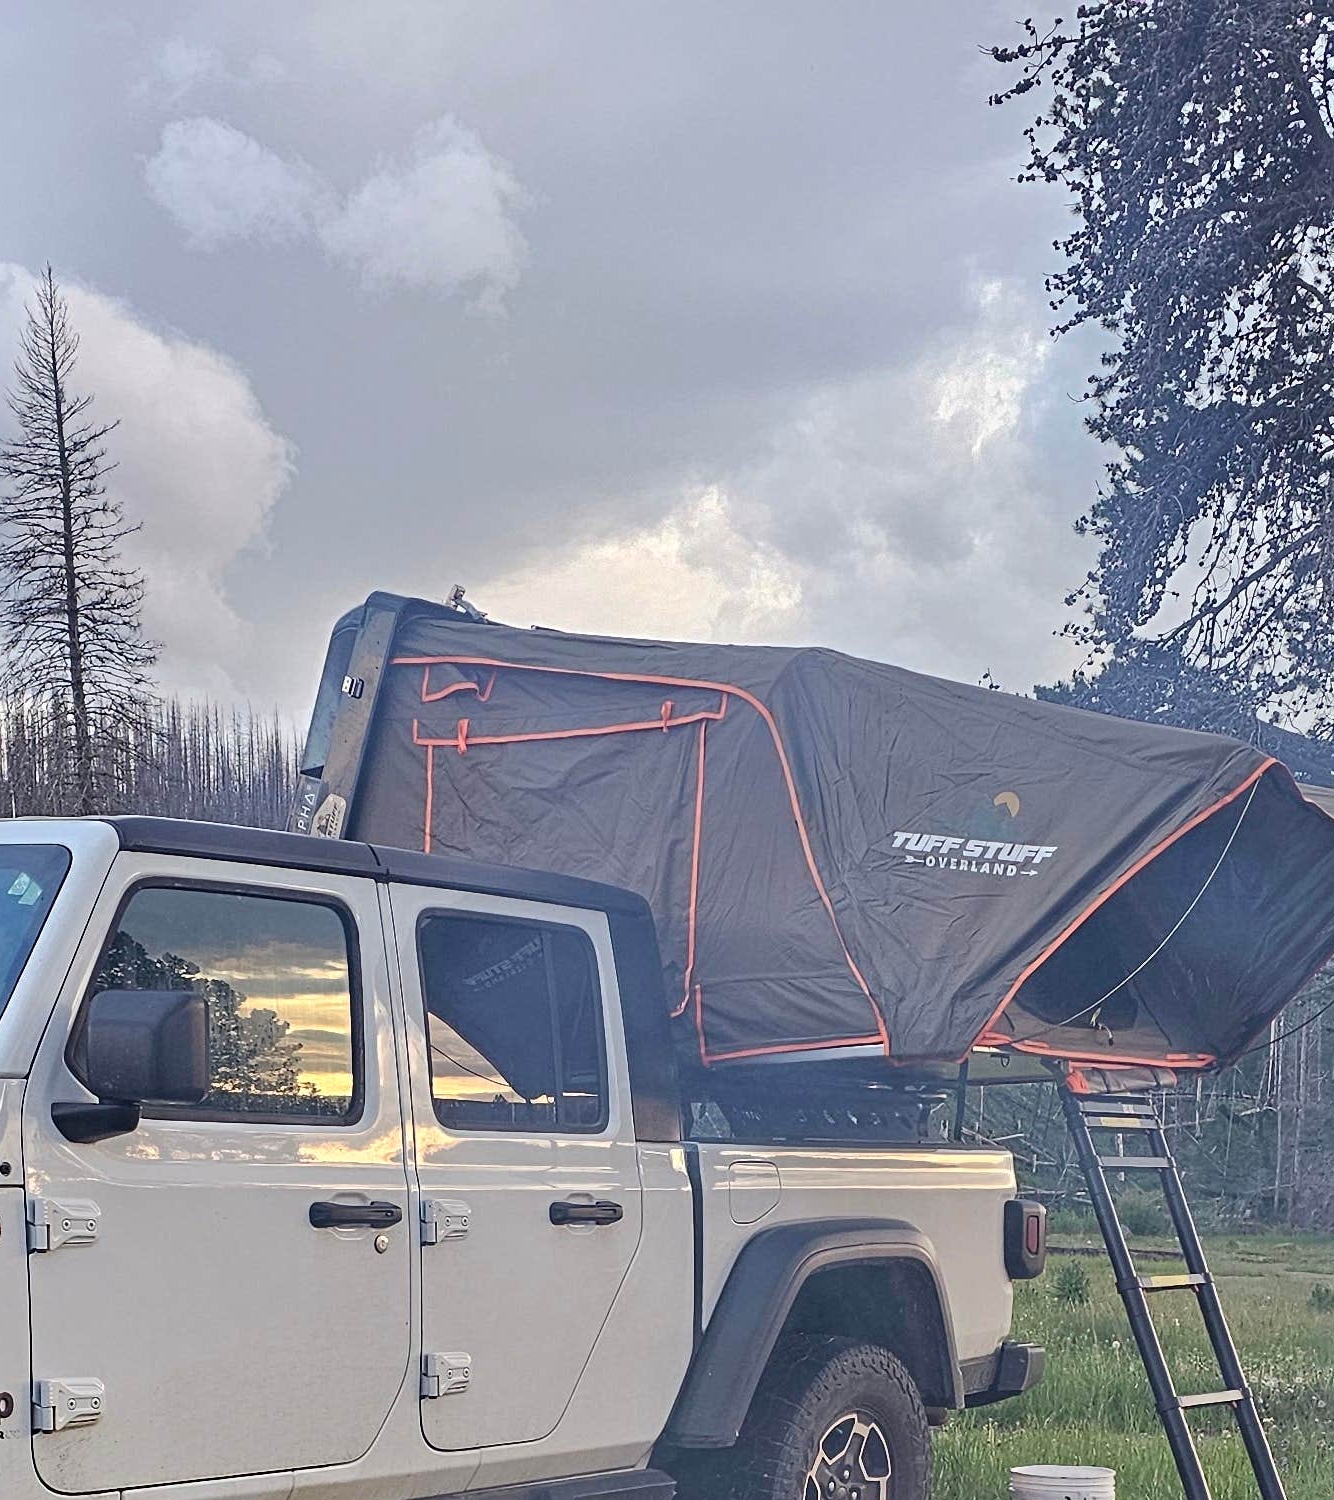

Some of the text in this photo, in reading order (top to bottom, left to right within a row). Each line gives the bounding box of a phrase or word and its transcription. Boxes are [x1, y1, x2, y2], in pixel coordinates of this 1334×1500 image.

[892, 831, 1059, 864] TUFF STUFF
[925, 856, 1018, 877] OVERLAND
